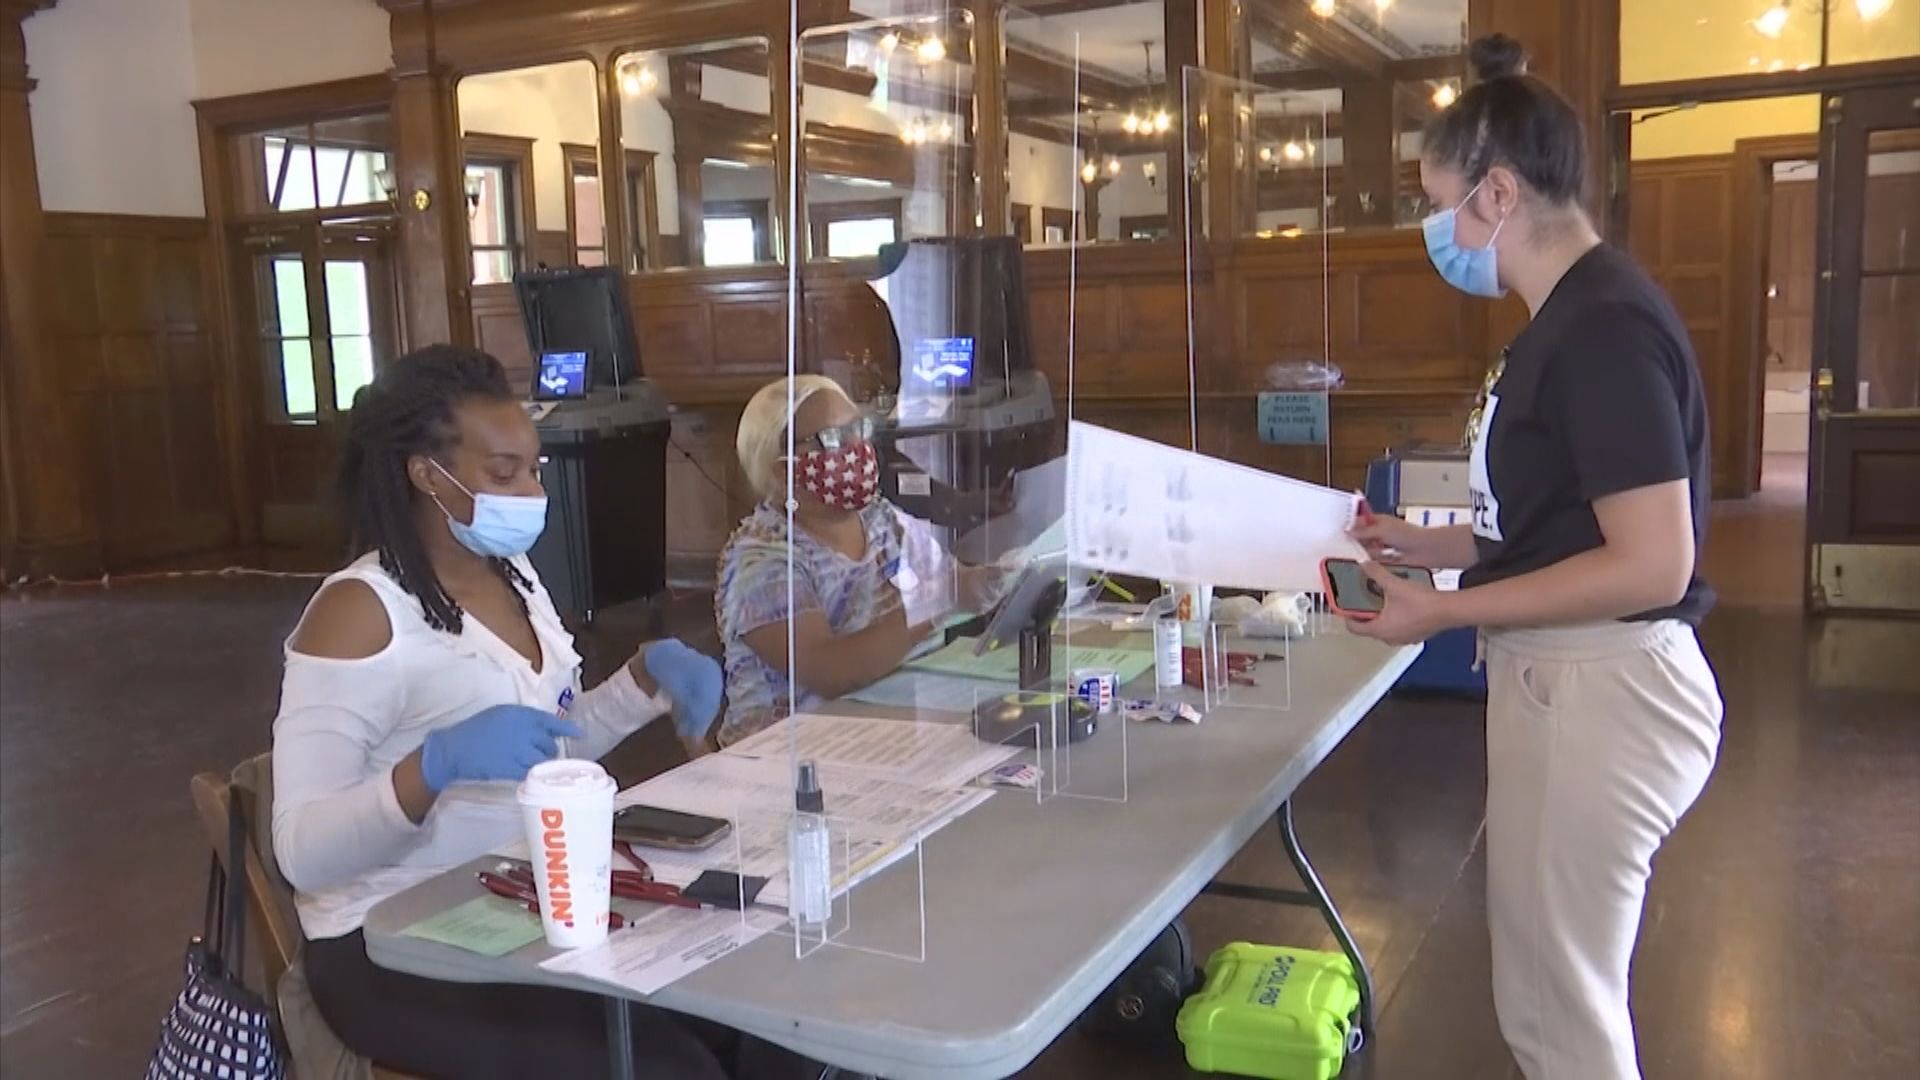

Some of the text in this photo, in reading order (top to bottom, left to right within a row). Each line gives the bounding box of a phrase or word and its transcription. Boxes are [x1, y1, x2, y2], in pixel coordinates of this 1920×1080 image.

[1272, 405, 1312, 414] RETURN
[1274, 394, 1310, 403] PLEASE
[1470, 489, 1493, 531] PE.
[540, 808, 574, 928] DUNKIN'
